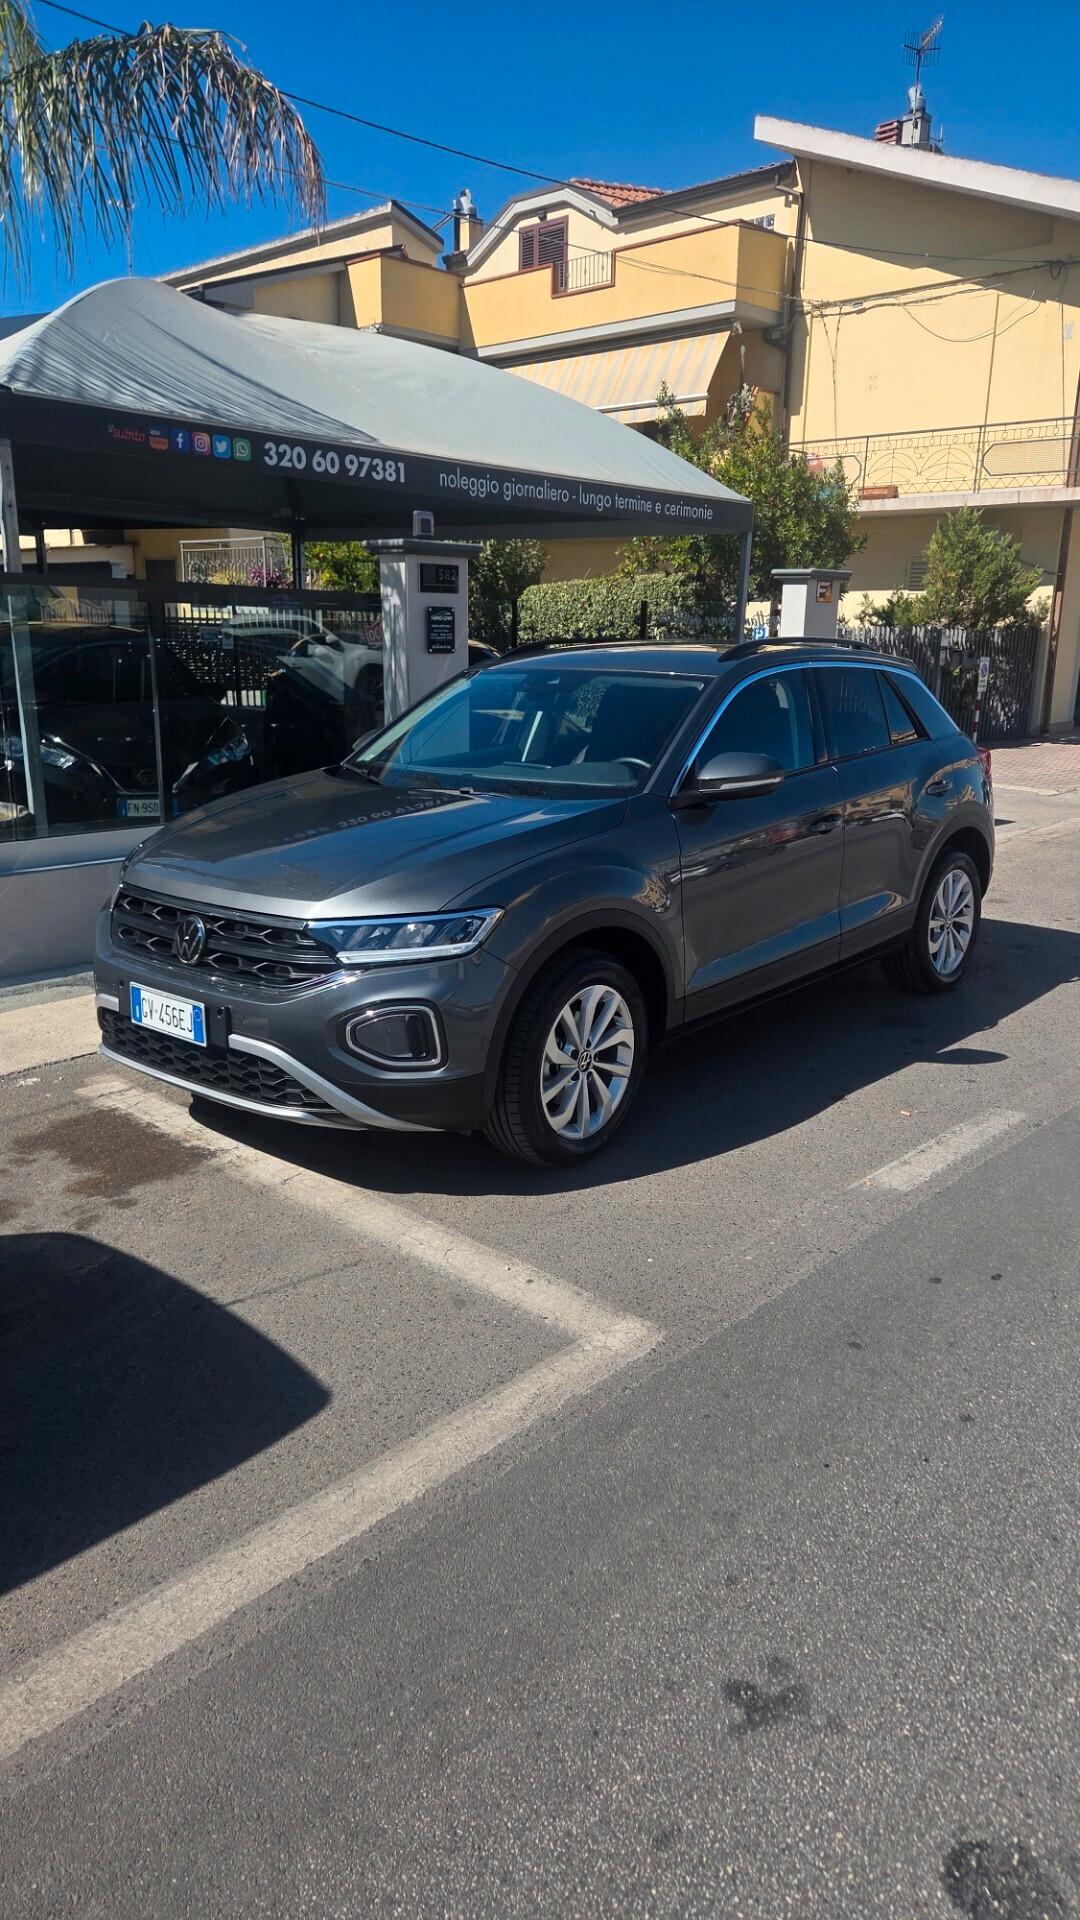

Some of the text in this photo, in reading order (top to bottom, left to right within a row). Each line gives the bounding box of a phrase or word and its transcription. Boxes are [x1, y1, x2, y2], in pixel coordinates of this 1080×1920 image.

[264, 441, 406, 483] 320 60 97381
[439, 466, 499, 498] noleggio
[503, 478, 569, 502] giornaliero
[579, 483, 612, 512] lungo
[615, 491, 653, 513] termine
[655, 502, 662, 514] e
[664, 501, 713, 520] cerimonie
